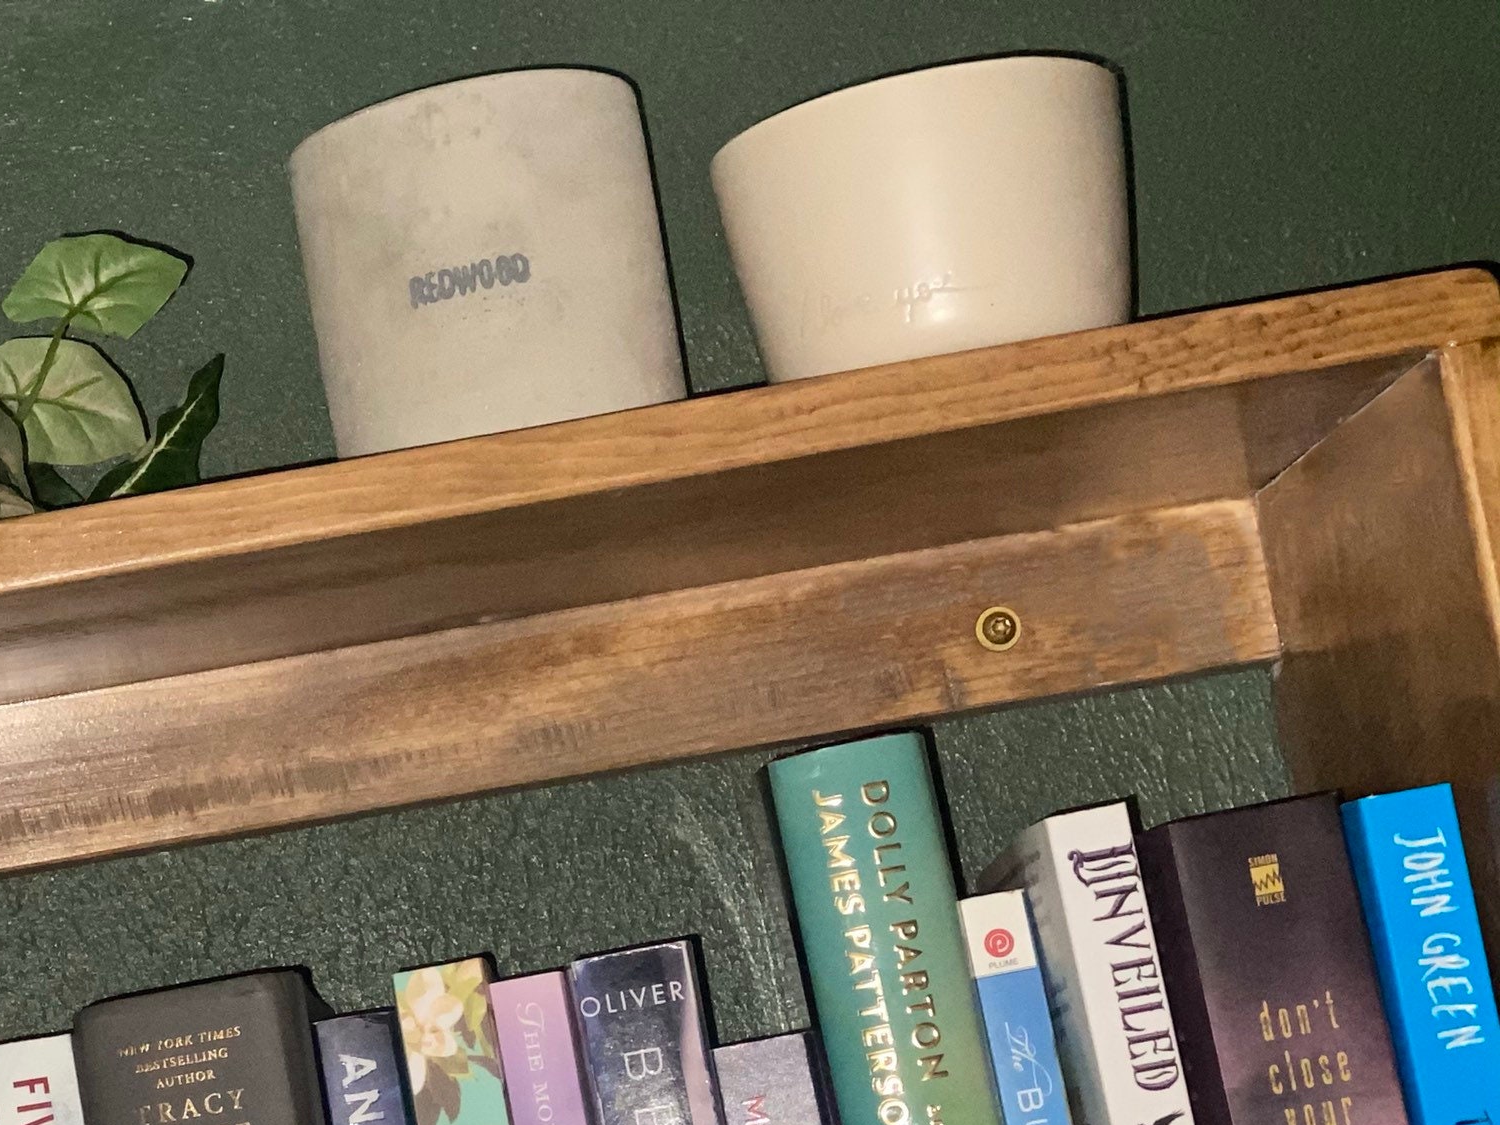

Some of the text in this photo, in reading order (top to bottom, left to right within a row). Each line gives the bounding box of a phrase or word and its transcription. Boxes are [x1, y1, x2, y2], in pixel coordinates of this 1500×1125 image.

[409, 253, 531, 309] REDWOOD
[812, 789, 866, 915] JAMES
[1248, 854, 1278, 867] SIMON
[1256, 892, 1287, 907] PULSE
[861, 780, 914, 904] DOLLY
[889, 919, 950, 1082] PARTON
[1393, 827, 1485, 1050] JOHN GREEN
[988, 958, 1019, 969] PLUME
[1067, 840, 1180, 1092] UNVEILED
[580, 980, 685, 1018] OLIVER
[1260, 991, 1339, 1042] don't
[197, 1025, 242, 1045] TIMES
[135, 1046, 229, 1075] BESTSELLING
[155, 1068, 217, 1090] AUTHOR
[1268, 1050, 1351, 1095] close
